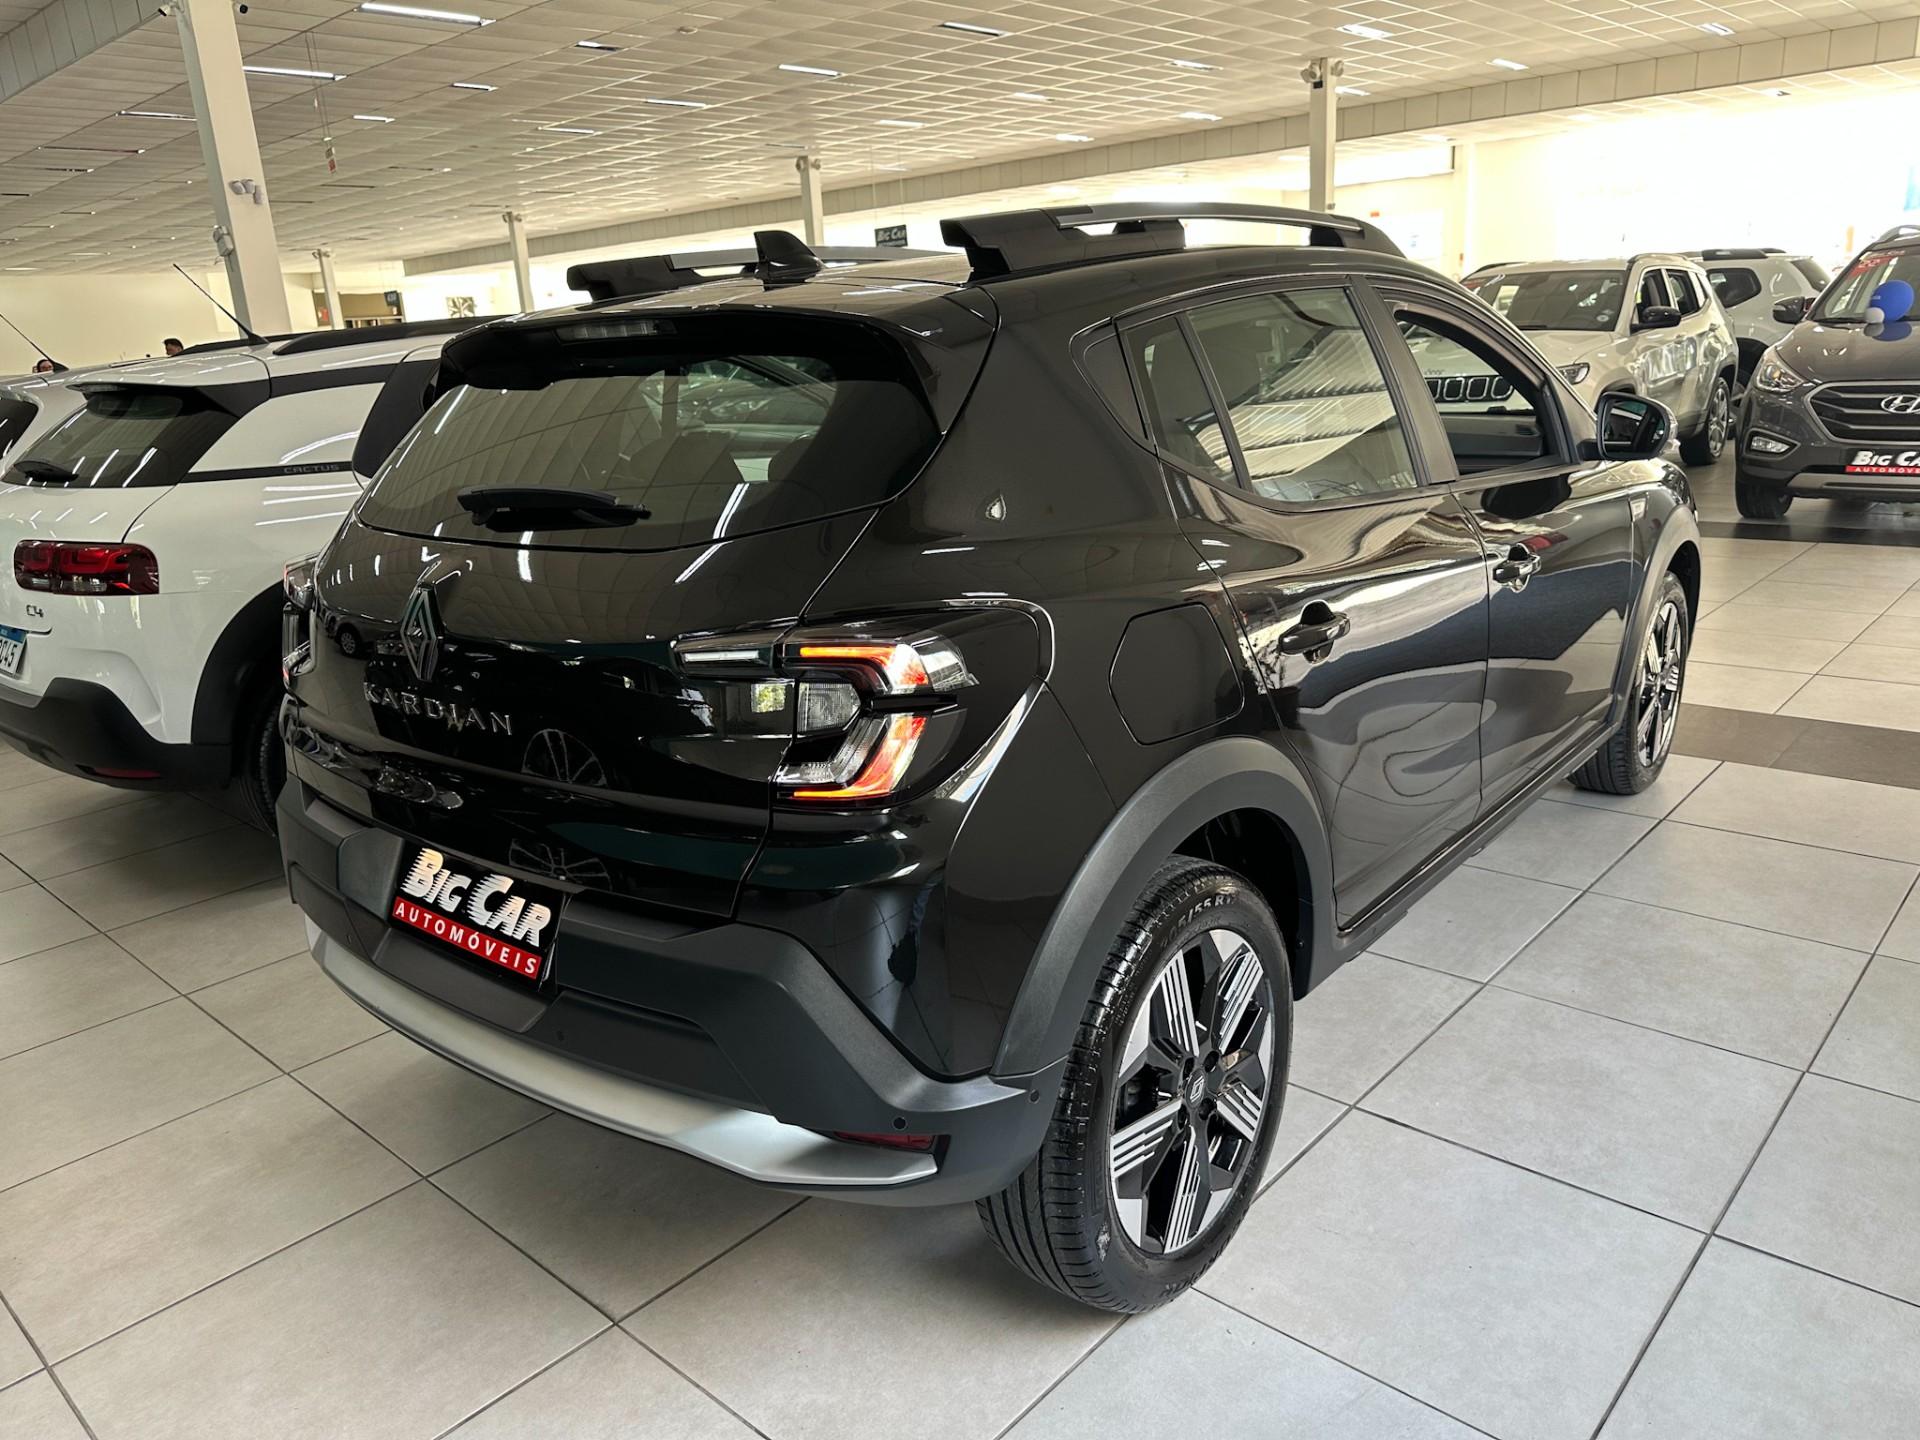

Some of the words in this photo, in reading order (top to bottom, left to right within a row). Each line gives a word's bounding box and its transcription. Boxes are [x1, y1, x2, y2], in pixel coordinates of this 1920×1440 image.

[284, 464, 340, 474] CACTUS
[1851, 450, 1893, 466] BIG
[26, 604, 44, 618] C4
[363, 682, 512, 736] KARDIAN
[400, 848, 472, 913] BIG
[466, 873, 552, 948] CAR
[395, 902, 537, 974] AUTOMÓVEIS
